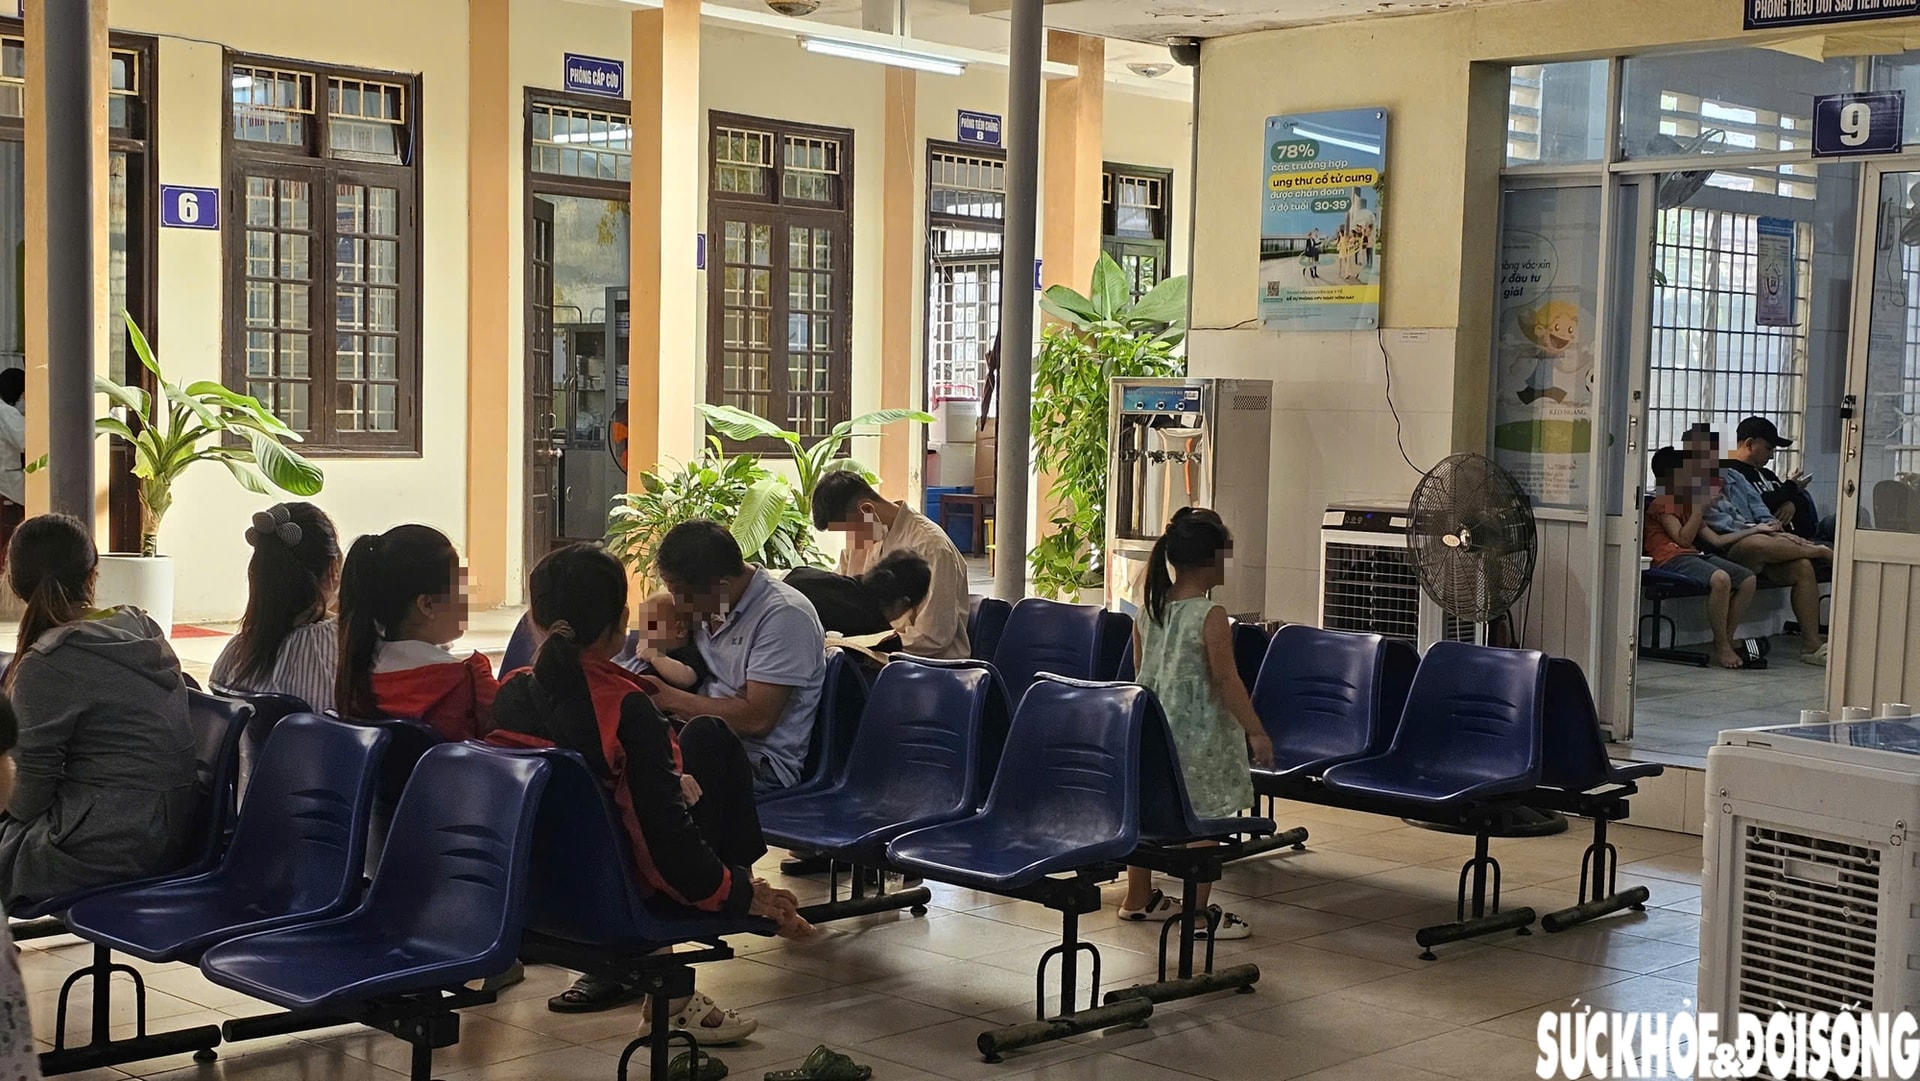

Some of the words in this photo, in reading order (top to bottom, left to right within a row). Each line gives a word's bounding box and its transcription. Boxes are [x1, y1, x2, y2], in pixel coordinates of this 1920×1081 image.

[569, 65, 592, 85] PHÒNG
[592, 67, 606, 87] CẤP
[1840, 102, 1871, 147] 9
[976, 130, 984, 141] 8
[1277, 143, 1315, 159] 78%
[1271, 162, 1290, 172] các
[1292, 160, 1326, 171] trường
[1328, 159, 1348, 170] hợp
[1272, 178, 1293, 188] ung
[1294, 176, 1313, 186] thư
[1330, 172, 1343, 183] tử
[1344, 173, 1373, 185] cung
[1270, 189, 1293, 200] được
[1320, 184, 1345, 196] đoán
[178, 192, 199, 223] 6
